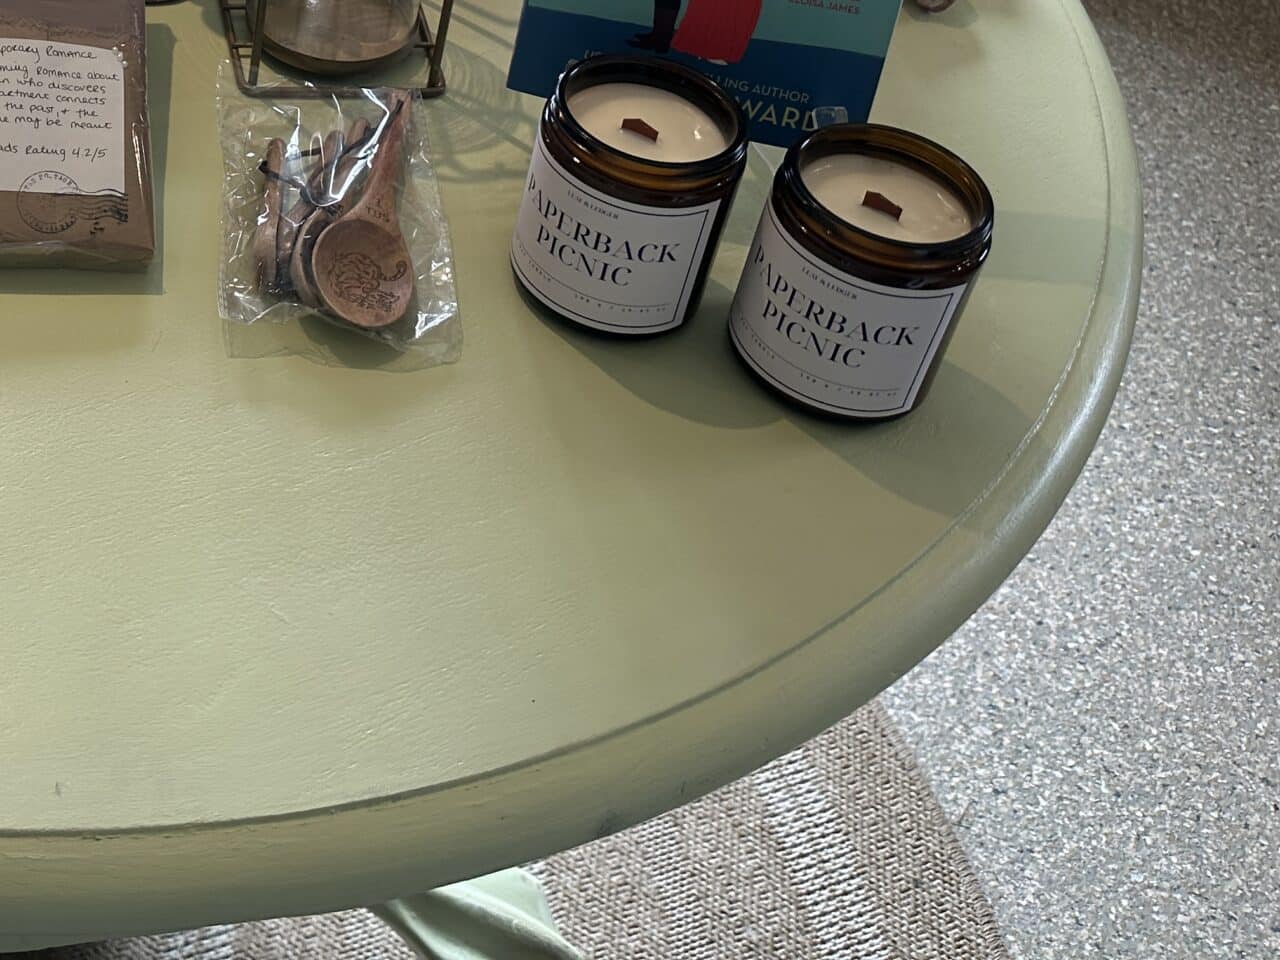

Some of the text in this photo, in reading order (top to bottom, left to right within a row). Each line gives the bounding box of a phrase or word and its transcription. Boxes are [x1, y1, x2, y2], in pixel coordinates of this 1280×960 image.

[87, 70, 120, 81] about
[16, 78, 43, 88] who
[48, 81, 106, 94] discovers
[752, 83, 810, 104] AUTHOR
[55, 94, 106, 105] connects
[5, 101, 23, 110] the
[76, 107, 99, 117] the
[14, 116, 42, 129] may
[46, 116, 63, 127] be
[70, 120, 113, 129] meant
[25, 146, 66, 161] Rating
[528, 172, 681, 264] PAPERBACK
[537, 223, 632, 288] PICNIC
[754, 244, 920, 346] PAPERBACK
[762, 299, 866, 369] PICNIC
